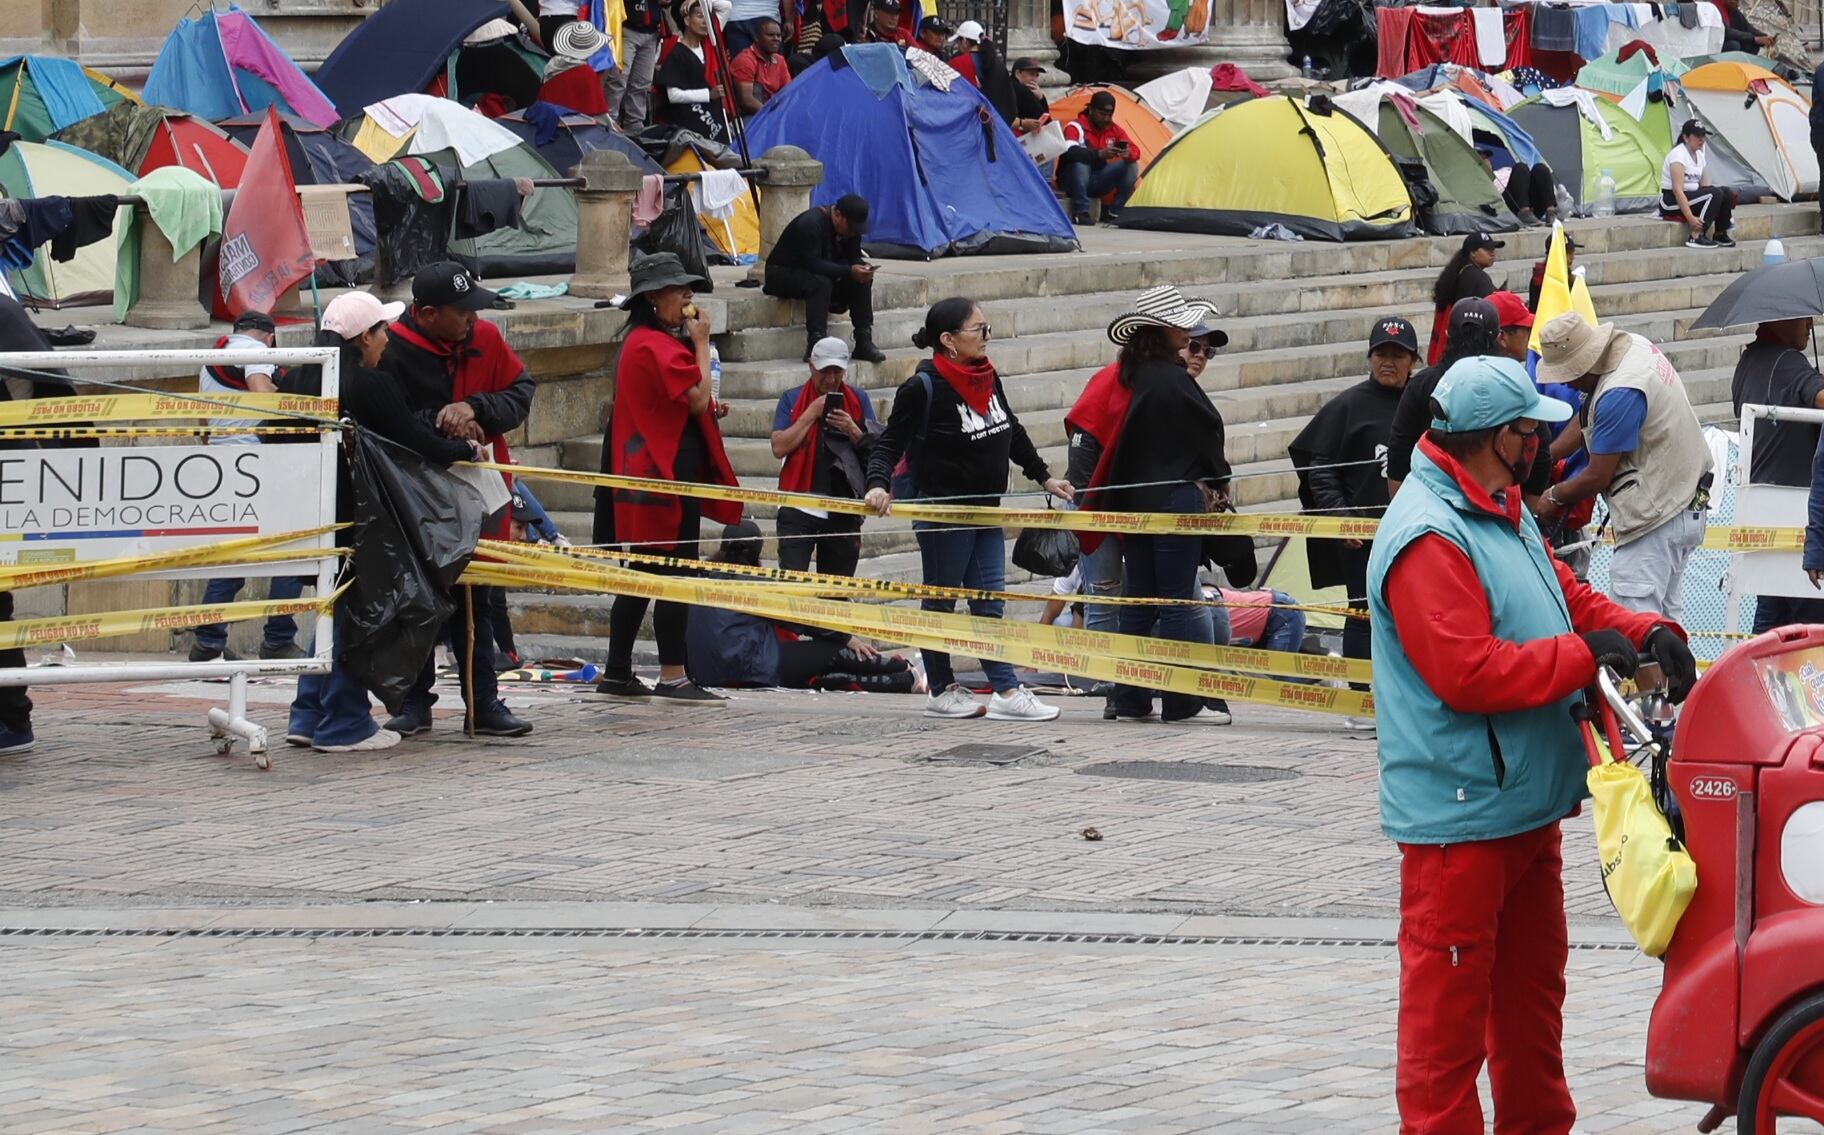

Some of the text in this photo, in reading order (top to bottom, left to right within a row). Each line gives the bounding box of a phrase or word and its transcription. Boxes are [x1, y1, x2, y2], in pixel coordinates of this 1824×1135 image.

[31, 405, 51, 415] PASE
[67, 401, 101, 413] PELIGRO
[155, 400, 176, 411] PASE
[278, 399, 299, 410] PASE
[5, 502, 260, 529] LA DEMOCRACIA
[155, 614, 188, 628] PELIGRO
[202, 612, 224, 624] PASE
[30, 624, 65, 639] PELIGRO
[78, 623, 100, 636] PASE
[1032, 649, 1046, 662] PASE
[1056, 652, 1080, 667] PELIGRO
[1116, 664, 1129, 677] PASE
[1140, 668, 1162, 681] PELIGRO
[1199, 675, 1212, 689] PASE
[1222, 678, 1245, 693] PELIGRO
[1280, 687, 1294, 701] PASE
[1304, 690, 1328, 706] PELIGRO
[1695, 780, 1732, 796] 2426
